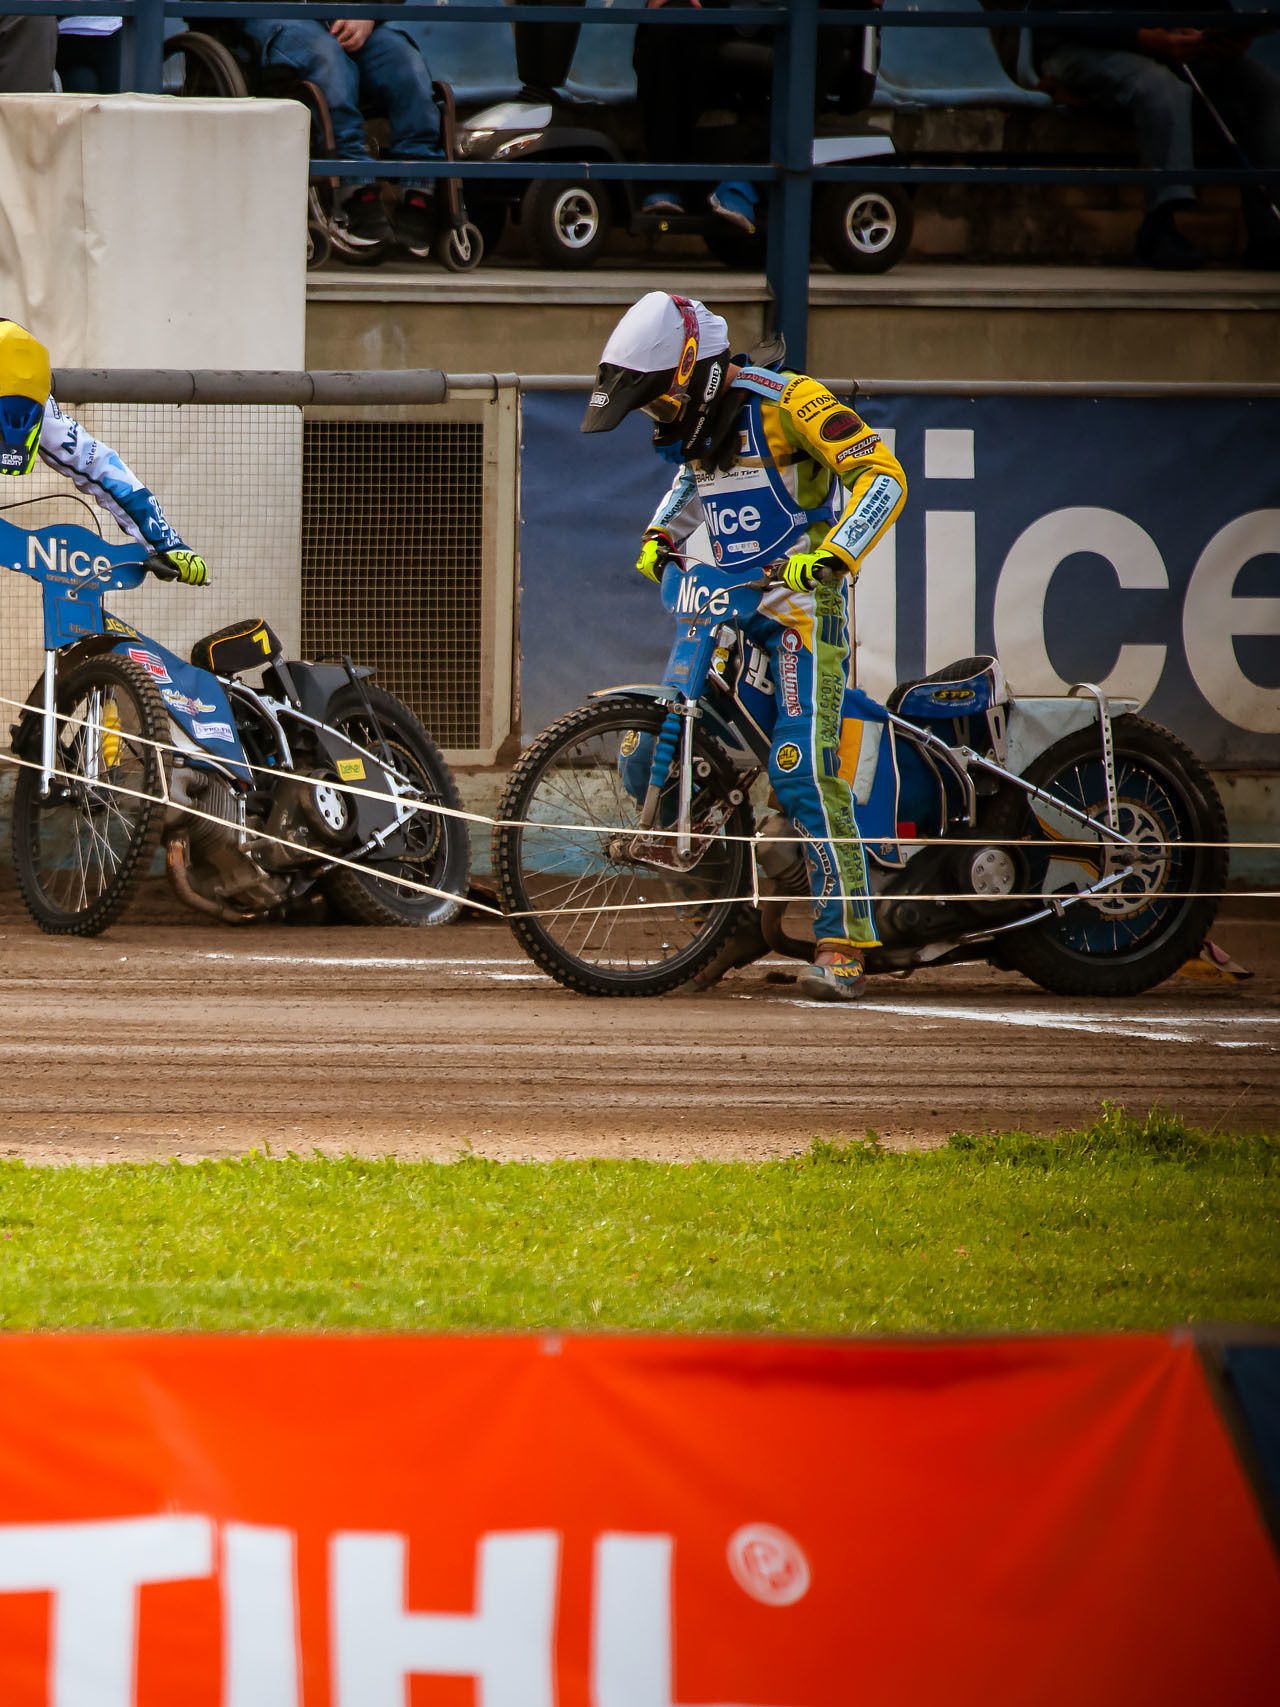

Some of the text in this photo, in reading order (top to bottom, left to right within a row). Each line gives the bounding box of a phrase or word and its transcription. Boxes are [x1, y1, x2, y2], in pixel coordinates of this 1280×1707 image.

[706, 367, 720, 397] SHOEI
[696, 472, 716, 483] BARO
[702, 501, 761, 537] Nice
[27, 535, 113, 582] Nice
[676, 575, 731, 616] Nice
[252, 629, 271, 655] 7
[939, 690, 970, 699] STP
